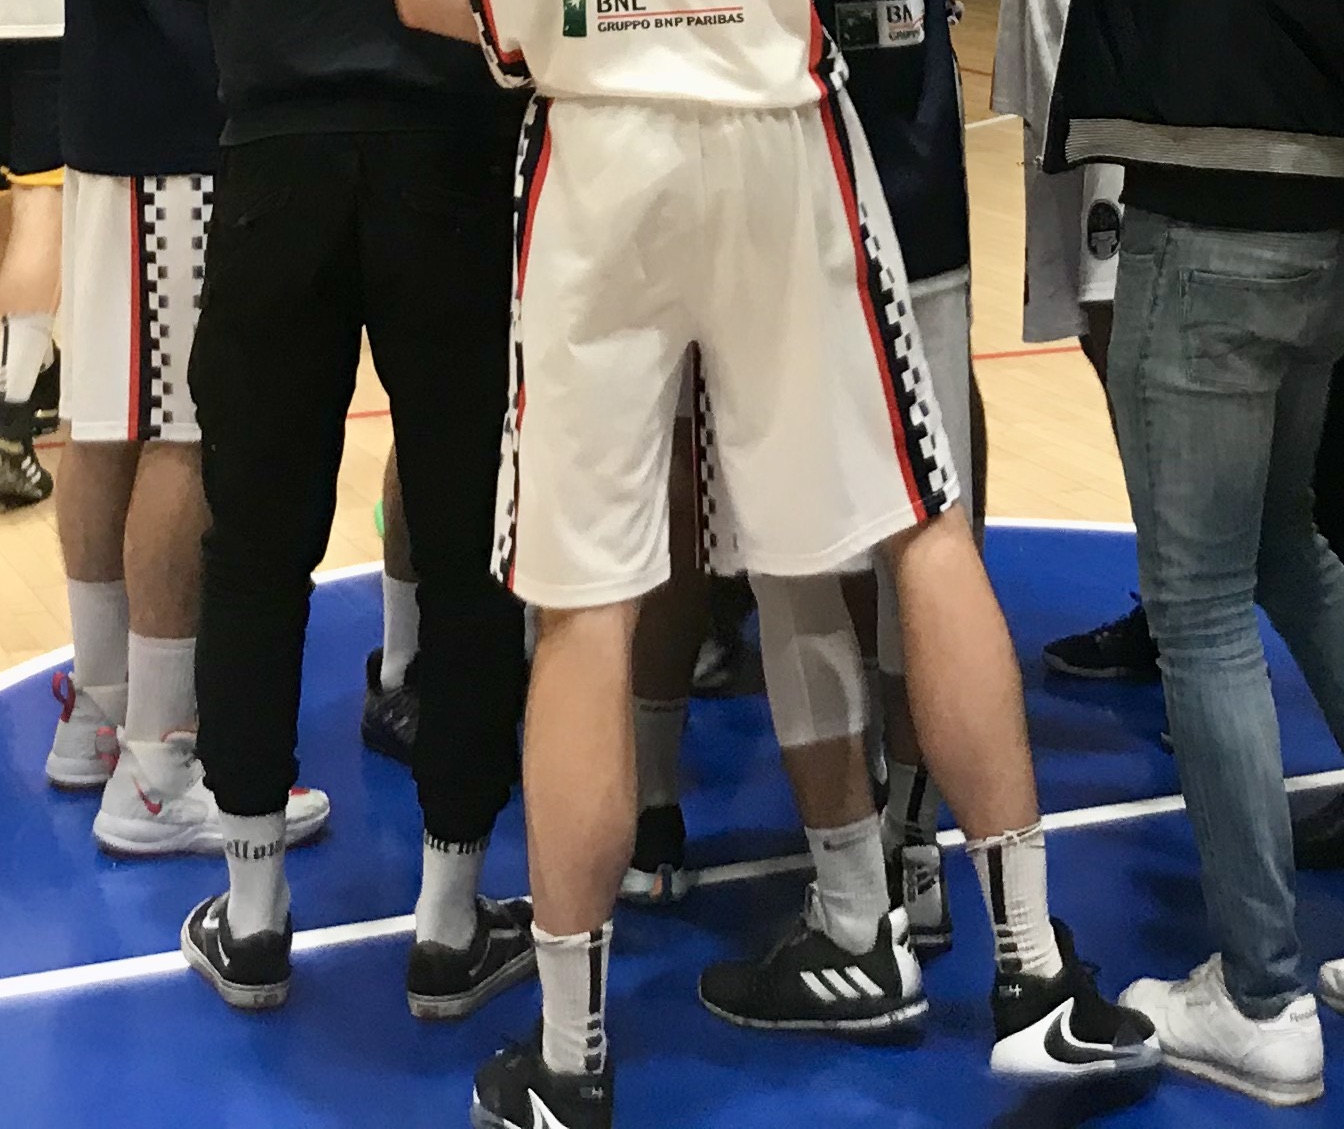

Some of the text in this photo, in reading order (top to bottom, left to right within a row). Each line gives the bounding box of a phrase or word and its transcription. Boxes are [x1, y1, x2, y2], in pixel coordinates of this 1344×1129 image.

[597, 12, 745, 33] GRUPPO BNP PARIBAS
[886, 4, 913, 24] BN
